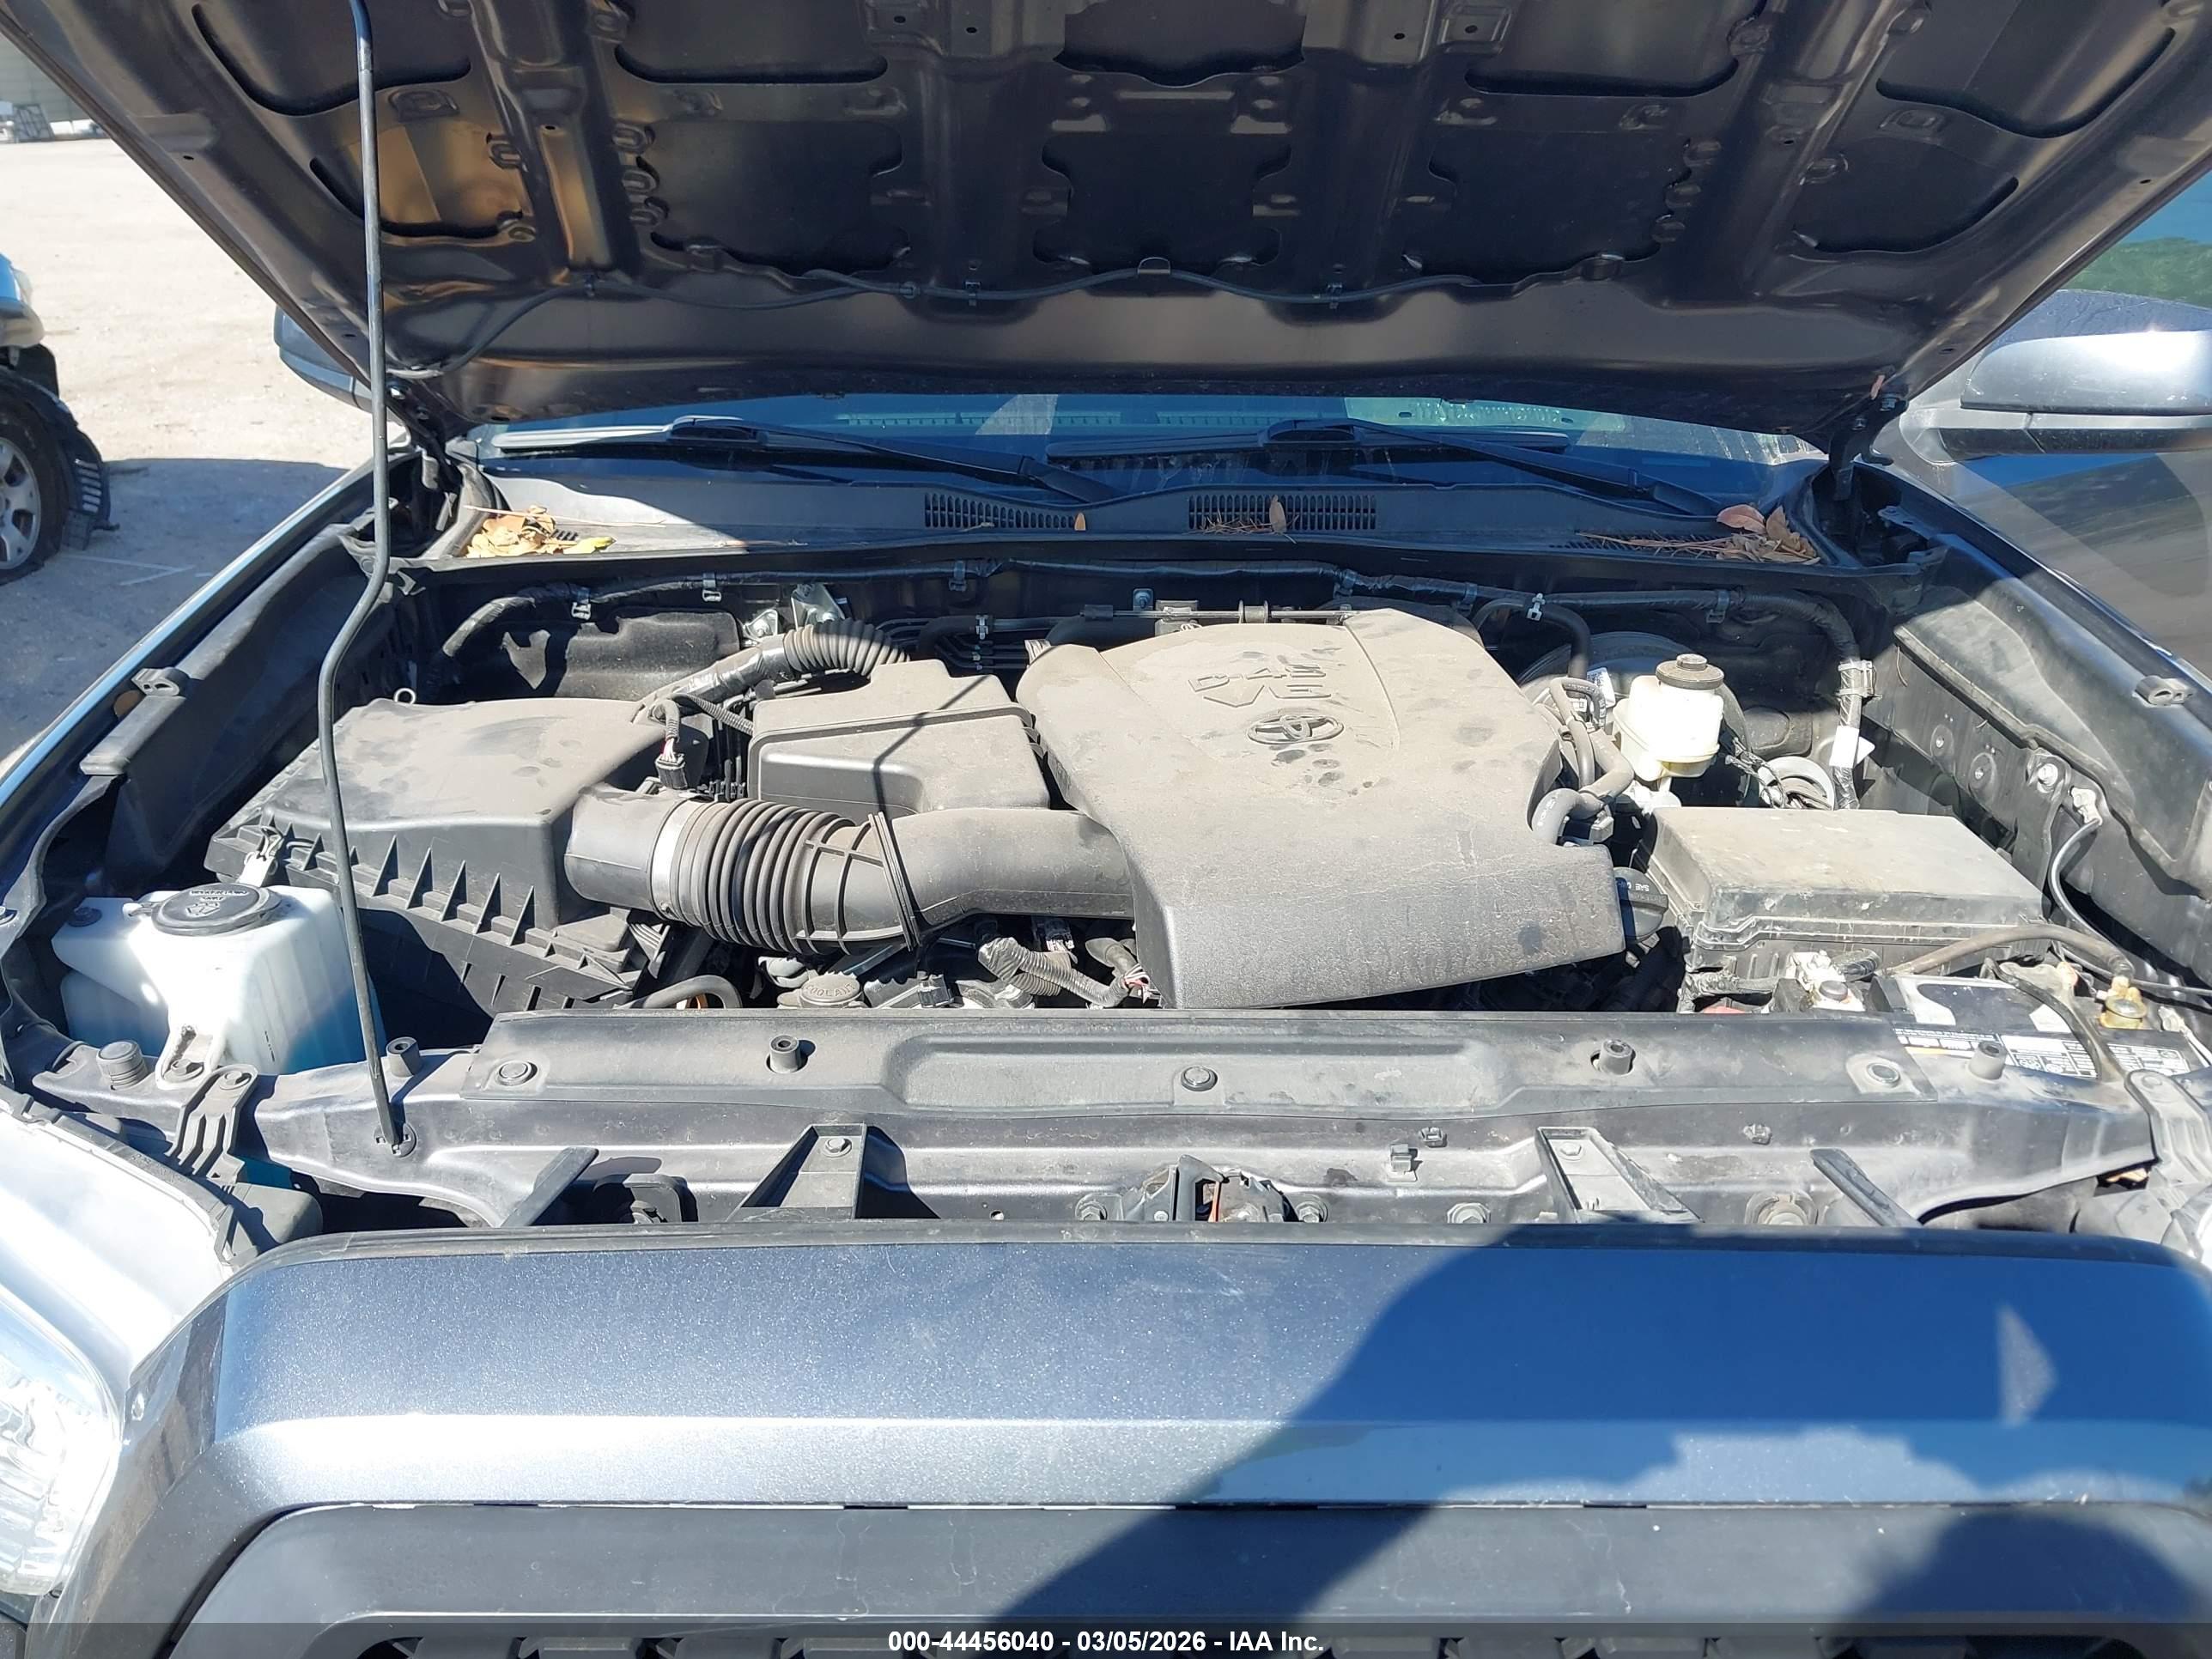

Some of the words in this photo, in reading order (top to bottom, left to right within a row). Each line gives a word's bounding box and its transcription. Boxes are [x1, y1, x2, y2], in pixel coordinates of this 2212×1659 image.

[1188, 664, 1326, 693] D-4S
[1635, 883, 1650, 892] SAE
[805, 983, 855, 997] COOLANT
